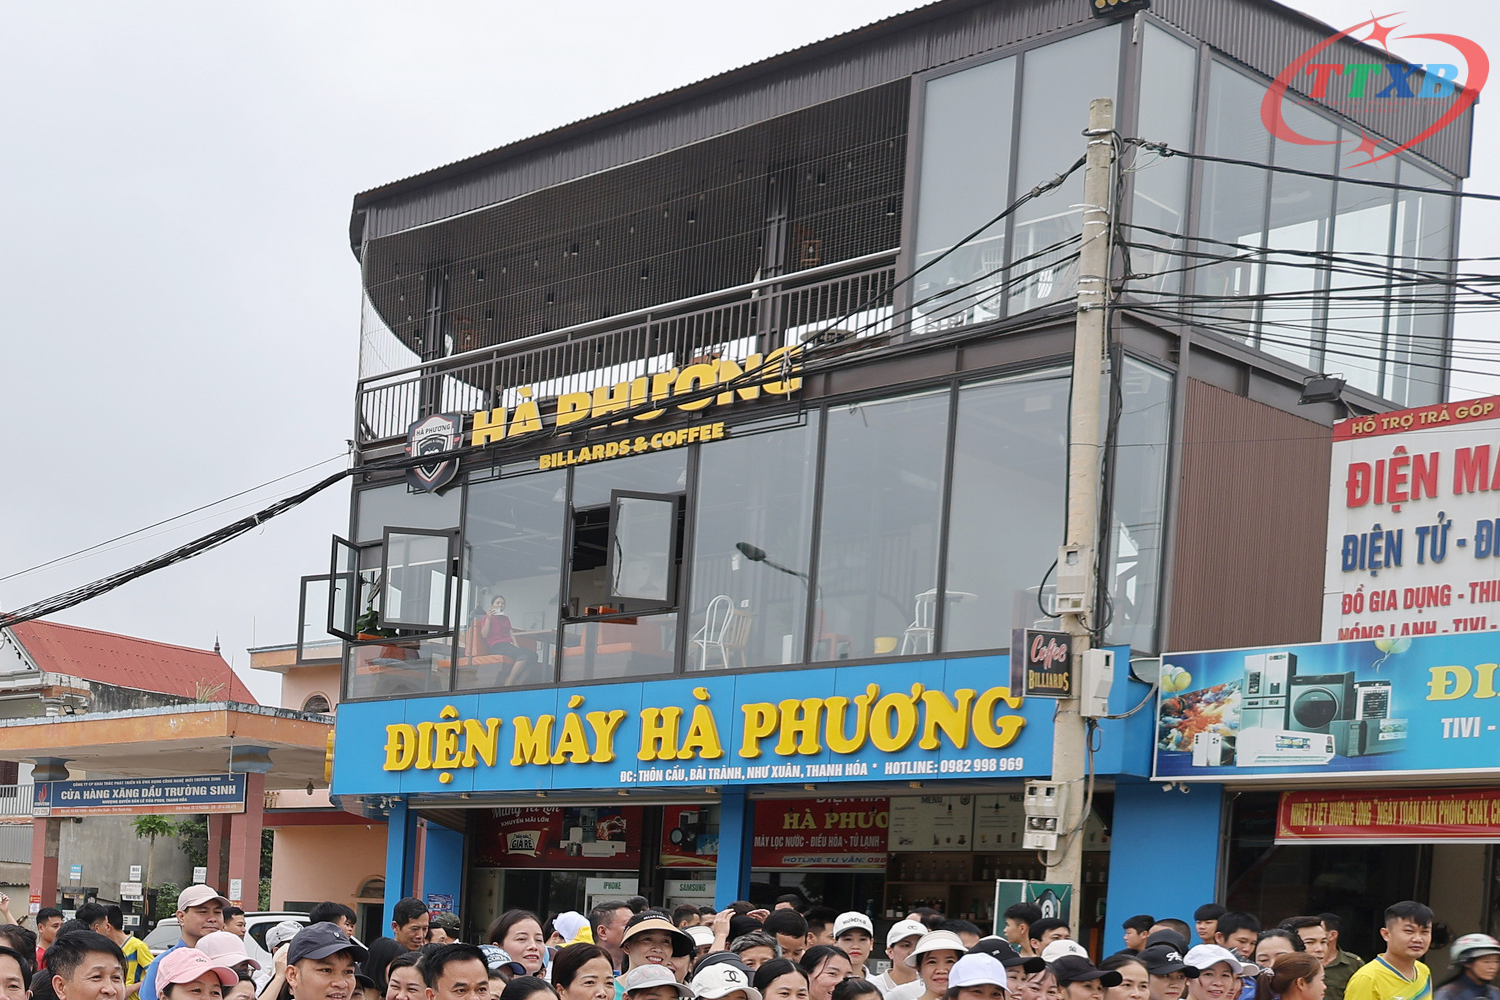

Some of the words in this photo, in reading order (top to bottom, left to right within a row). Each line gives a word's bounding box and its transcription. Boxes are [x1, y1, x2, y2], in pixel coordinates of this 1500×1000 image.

[471, 388, 544, 446] HÀ
[556, 346, 803, 436] PHƯƠNG
[1351, 414, 1377, 435] HỖ
[1381, 412, 1414, 431] TRỢ
[1419, 405, 1451, 424] TRẢ
[1454, 400, 1495, 420] GÓP
[539, 440, 629, 470] BILLARDS
[632, 436, 648, 453] &
[650, 422, 726, 450] COFFEE
[1346, 445, 1440, 513] ĐIỆN
[1341, 523, 1404, 577] ĐIỆN
[1415, 511, 1452, 565] TỬ
[1341, 584, 1365, 615] ĐỒ
[1369, 589, 1398, 613] GIA
[1403, 584, 1452, 614] DỤNG
[1031, 634, 1068, 670] Coffee
[1028, 669, 1069, 691] BILLIARDS
[383, 705, 501, 783] ĐIỆN
[510, 695, 626, 766] MÁY
[636, 686, 724, 762] HÀ
[739, 683, 1026, 760] PHƯƠNG
[1441, 716, 1481, 739] TIVI
[619, 770, 637, 783] ĐC:
[638, 766, 664, 783] THÔN
[665, 764, 688, 782] CẦU,
[689, 764, 707, 780] BÃI
[707, 763, 745, 781] TRÀNH,
[746, 763, 770, 779] NHƯ
[770, 763, 804, 779] XUÂN,
[806, 763, 843, 778] THANH
[845, 760, 868, 776] HÓA
[884, 761, 939, 776] HOTLINE:
[940, 759, 973, 774] 0982
[973, 758, 998, 773] 998
[999, 757, 1024, 772] 969
[60, 788, 81, 800] CỬA
[83, 788, 110, 799] HÀNG
[112, 787, 139, 798] XĂNG
[141, 785, 162, 797] DẦU
[165, 784, 207, 796] TRƯỜNG
[209, 784, 236, 796] SINH
[783, 807, 817, 830] HÀ
[754, 835, 770, 848] MÁY
[770, 836, 784, 849] LỌC
[785, 834, 805, 848] NƯỚC
[810, 833, 827, 848] ĐIỀU
[828, 834, 844, 848] HÒA
[849, 833, 859, 847] TỦ
[860, 836, 880, 850] LẠNH
[602, 881, 622, 890] IPHONE
[679, 883, 707, 892] SAMSUNG
